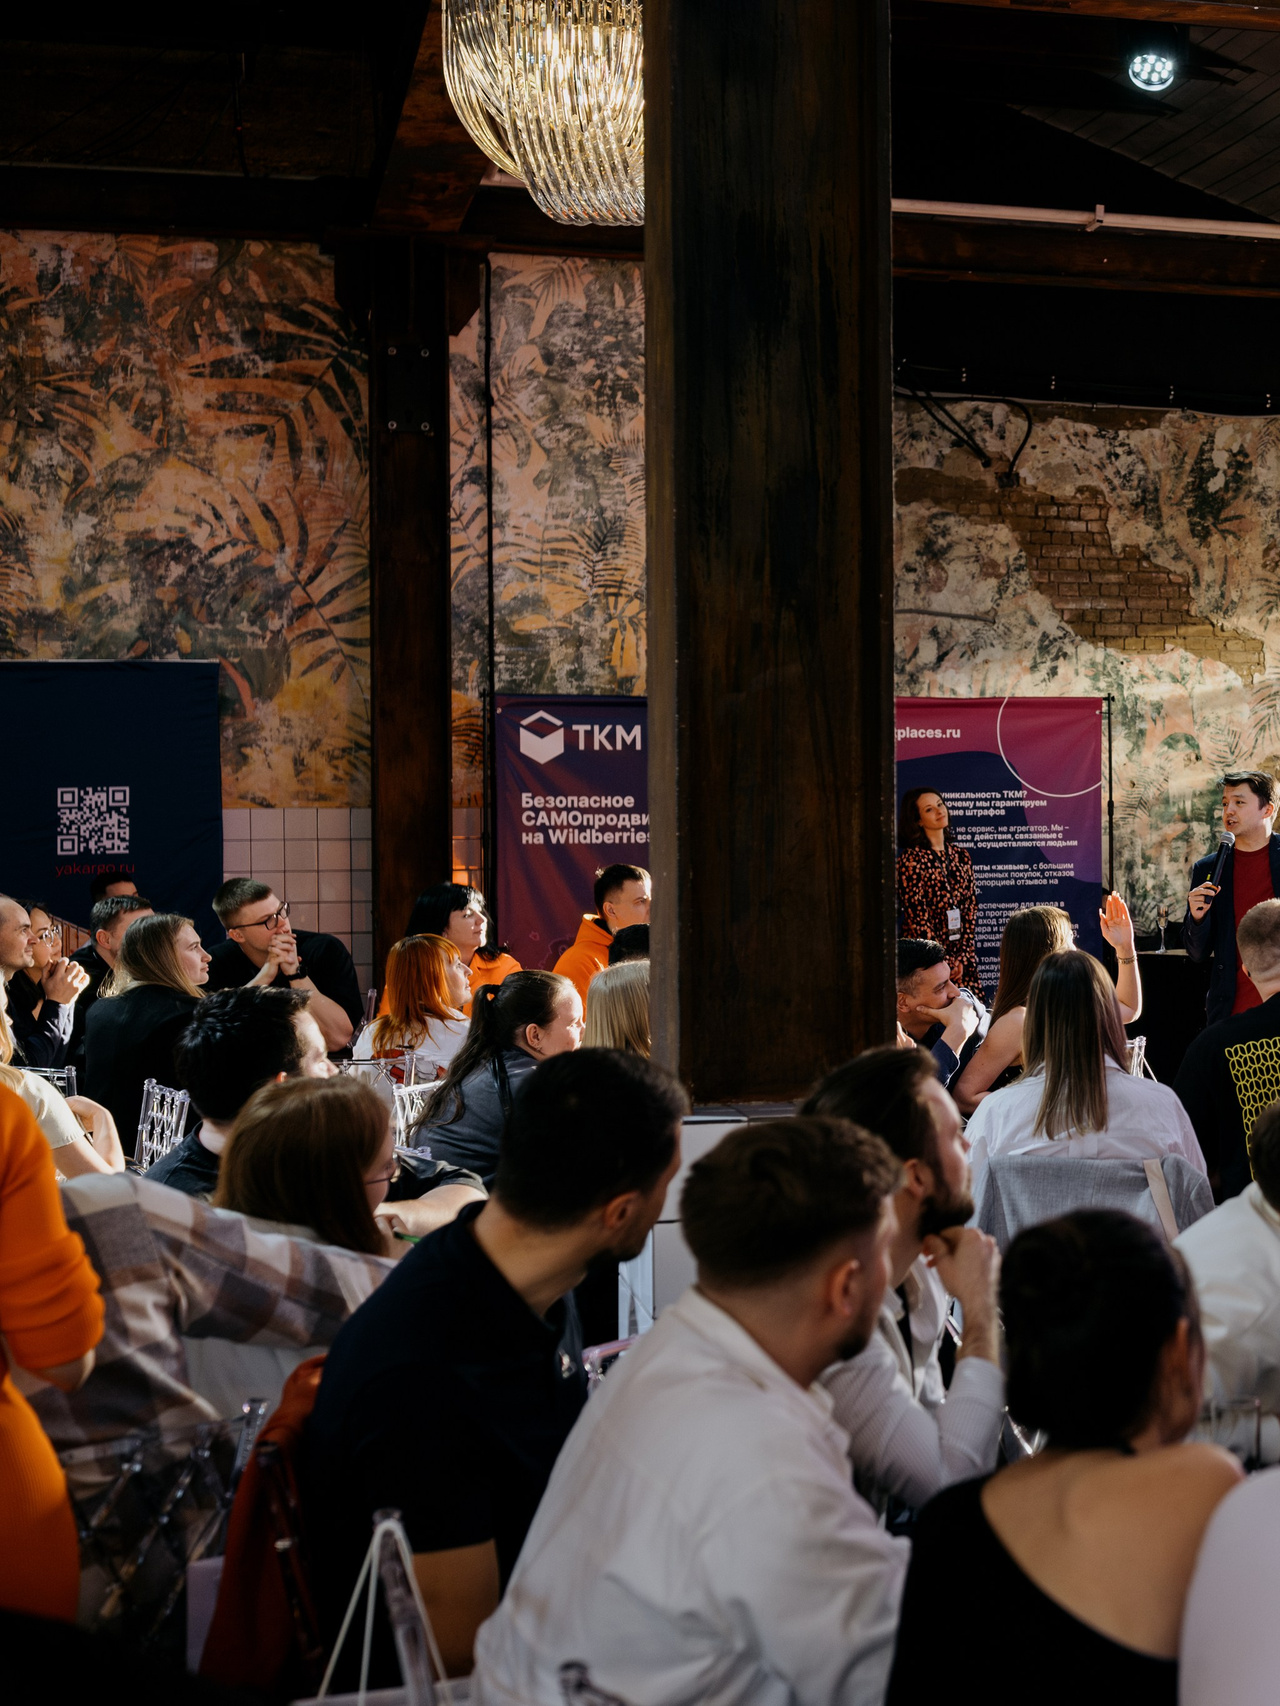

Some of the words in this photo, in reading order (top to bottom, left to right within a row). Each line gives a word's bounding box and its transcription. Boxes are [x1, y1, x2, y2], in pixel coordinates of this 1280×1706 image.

[1002, 790, 1028, 799] ТКМ?
[521, 792, 635, 808] Безопасное
[945, 800, 974, 808] очему
[991, 799, 1047, 808] гарантируем
[965, 808, 1006, 817] штрафов
[1009, 825, 1050, 833] агрегатор.
[521, 832, 544, 844] на
[974, 832, 1014, 841] действия,
[977, 841, 1046, 849] осуществляются
[1046, 840, 1078, 848] людьми
[56, 862, 135, 878] yakargoru
[1039, 862, 1074, 870] большим
